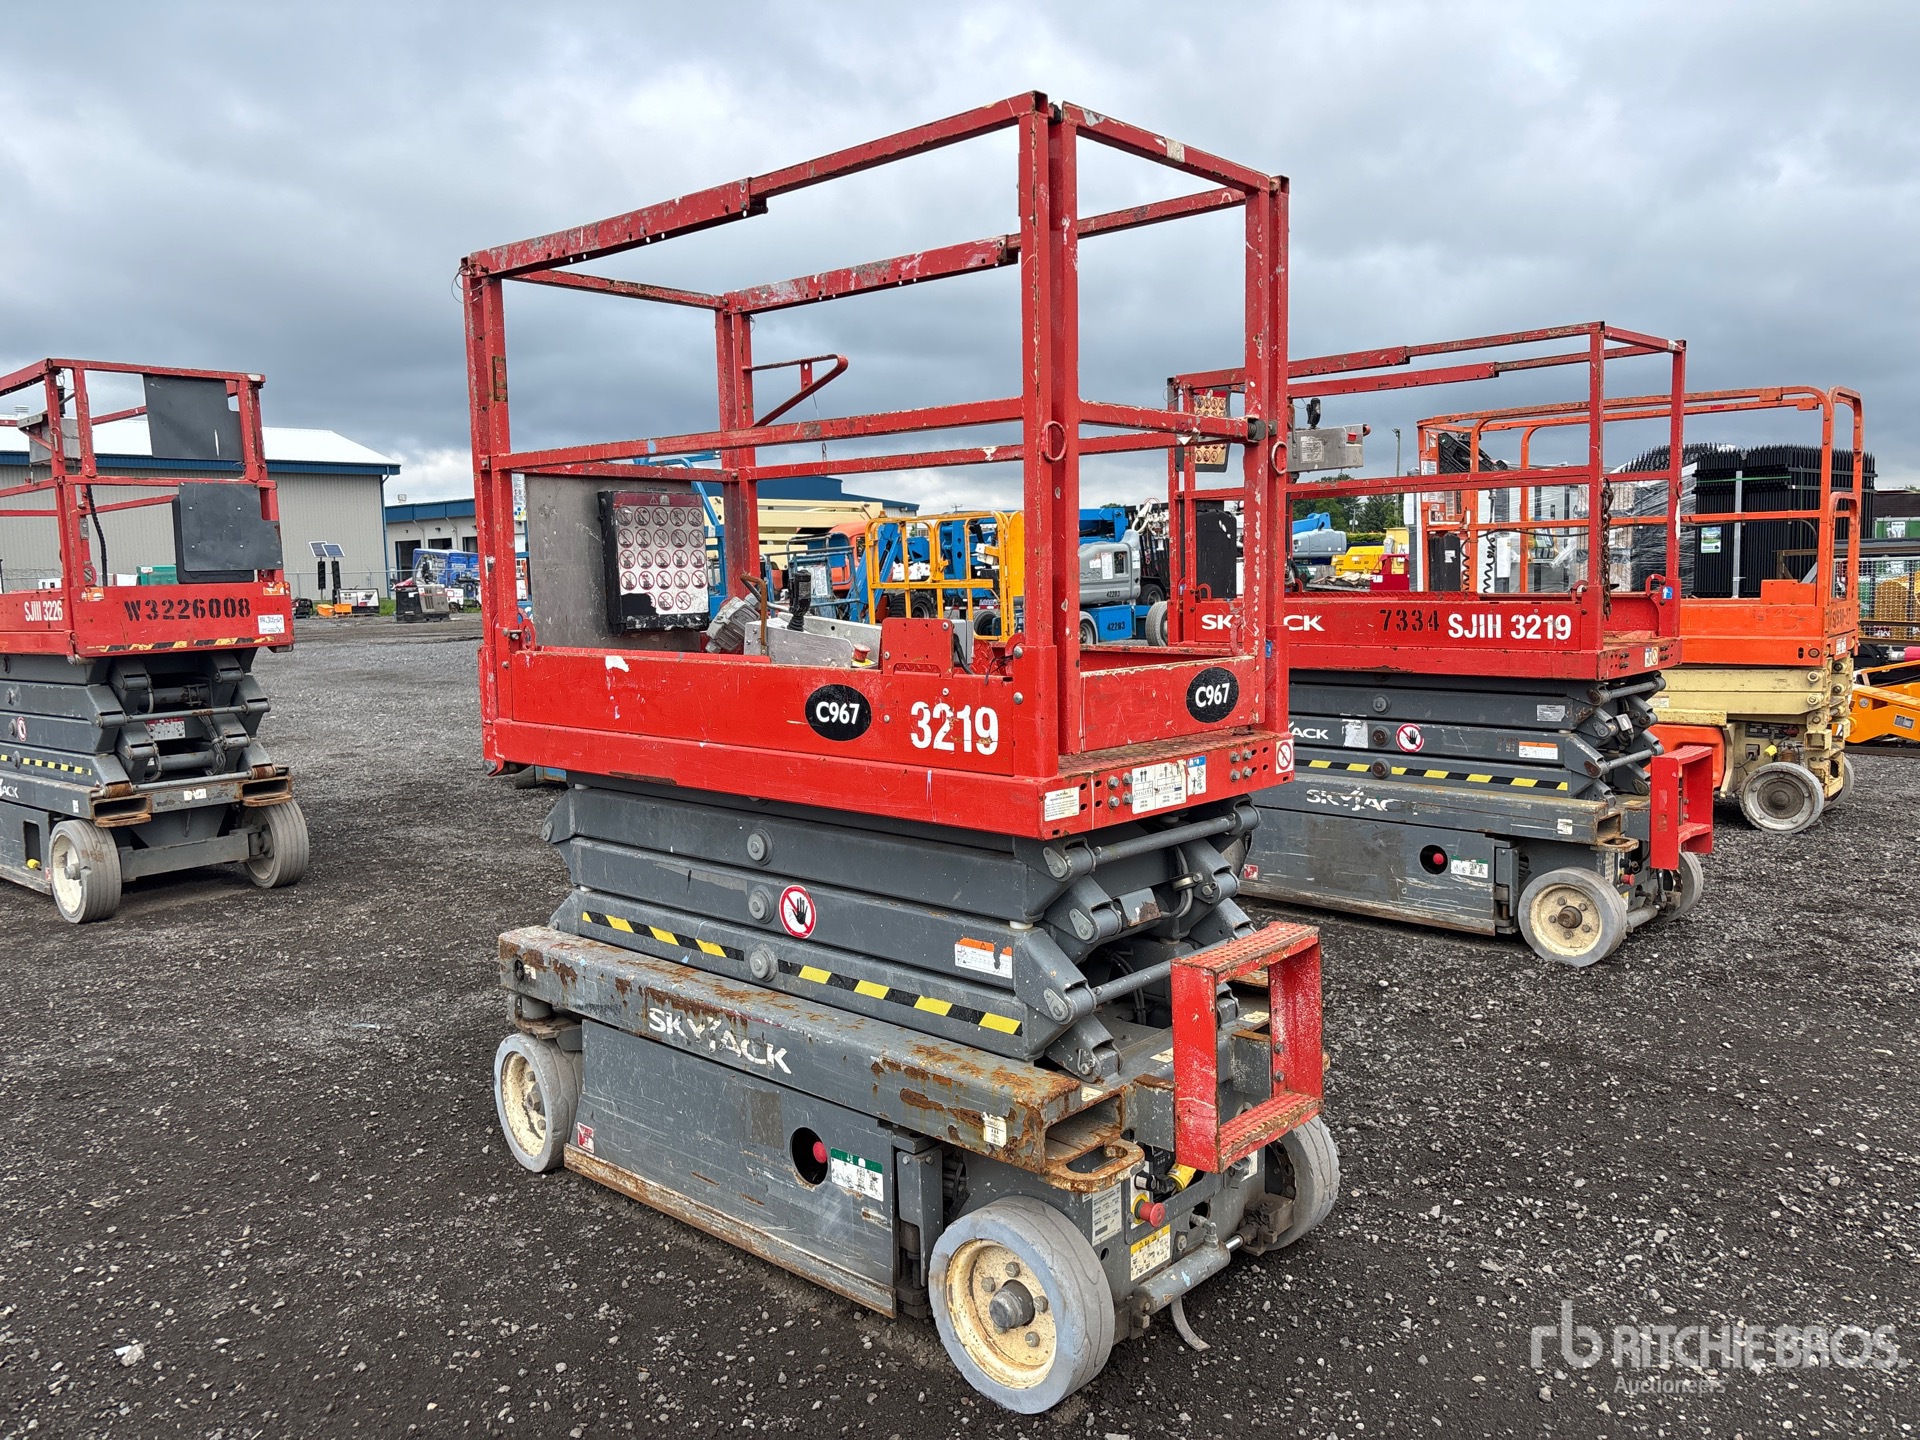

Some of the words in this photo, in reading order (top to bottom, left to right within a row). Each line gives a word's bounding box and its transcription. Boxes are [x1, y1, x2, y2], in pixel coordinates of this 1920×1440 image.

[43, 600, 63, 621] 3226
[124, 597, 251, 622] W3226008
[1379, 609, 1440, 632] 7334
[1510, 614, 1572, 640] 3219
[1195, 682, 1230, 708] C967
[815, 701, 860, 725] C967
[910, 701, 999, 755] 3219
